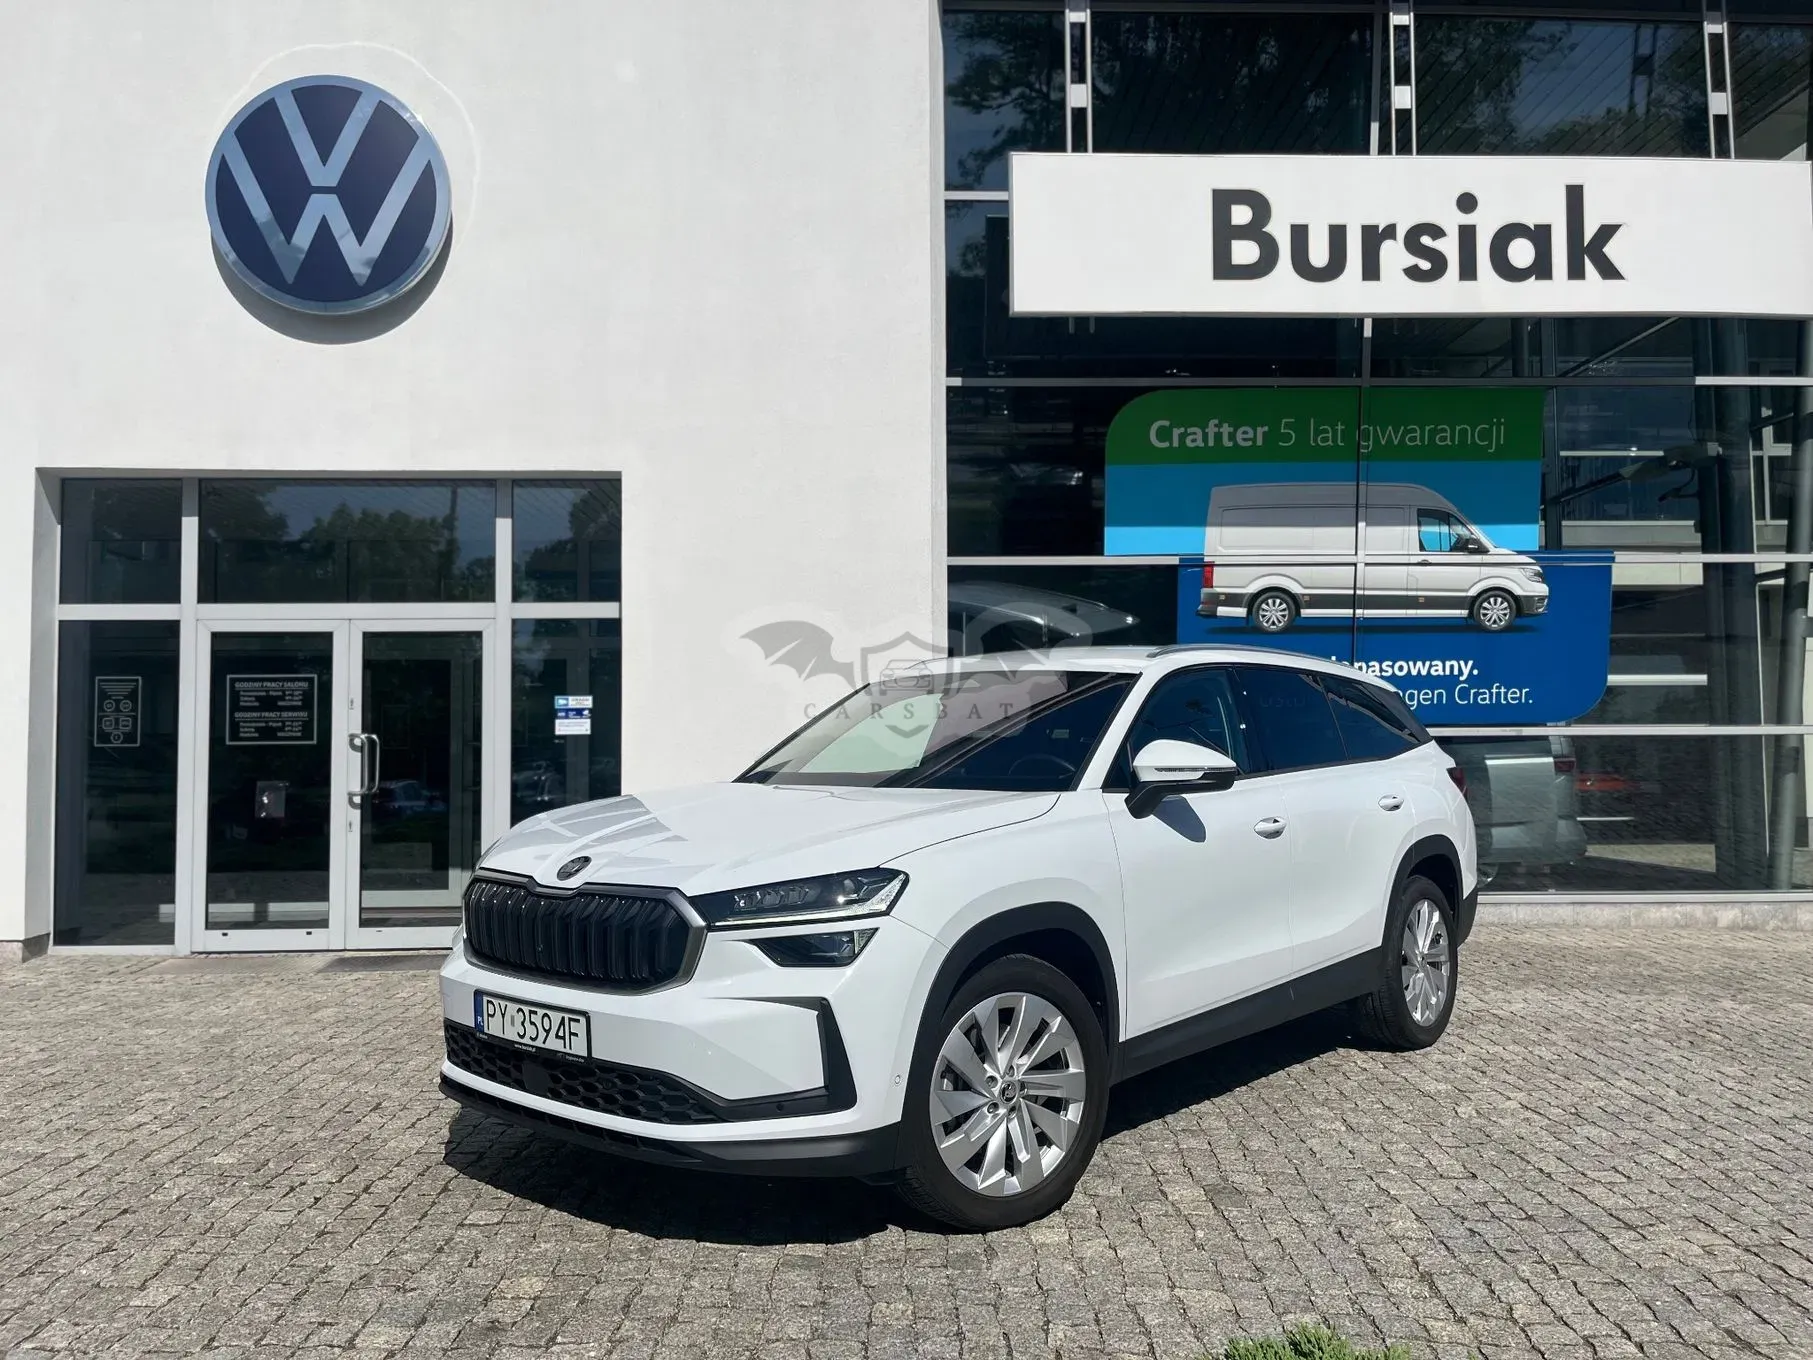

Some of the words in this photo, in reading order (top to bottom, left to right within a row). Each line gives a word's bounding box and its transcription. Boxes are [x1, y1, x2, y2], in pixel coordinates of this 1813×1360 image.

[1212, 184, 1627, 283] Bursiak
[1149, 419, 1268, 448] Crafter
[1278, 418, 1296, 446] 5
[1310, 418, 1346, 446] lat
[1356, 418, 1505, 452] gwarancji
[1454, 683, 1533, 704] Crafter.
[477, 1015, 485, 1026] PL
[486, 999, 508, 1035] PY
[516, 1007, 581, 1051] 3594F
